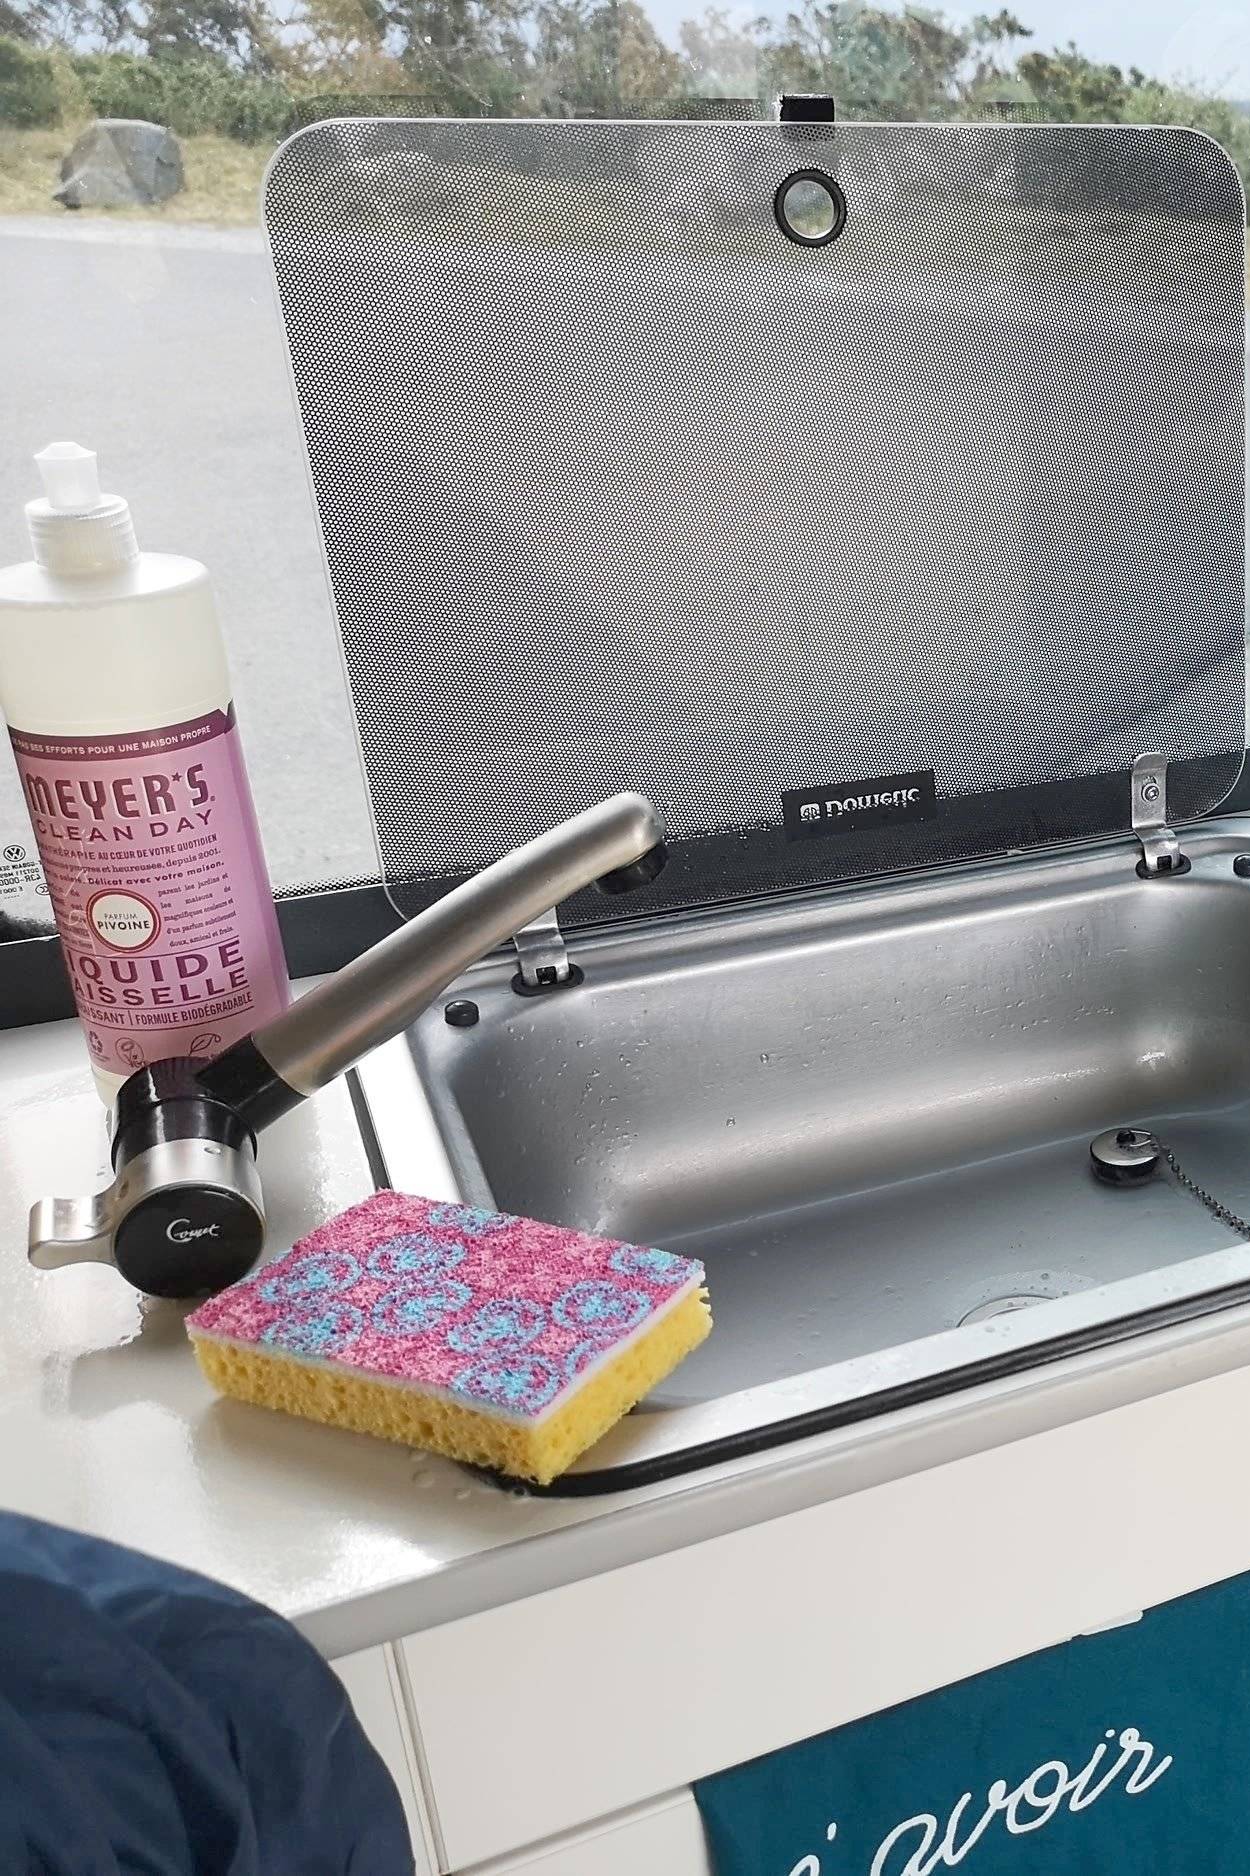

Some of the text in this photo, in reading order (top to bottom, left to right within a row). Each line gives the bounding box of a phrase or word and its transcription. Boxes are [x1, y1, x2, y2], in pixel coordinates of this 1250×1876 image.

[45, 745, 85, 755] EFFORTS
[88, 745, 115, 754] POUR
[119, 742, 140, 752] UNE
[142, 736, 178, 749] MAISON
[180, 725, 211, 741] PROPRE
[38, 809, 212, 842] CLEAN DAY
[98, 851, 108, 860] AU
[137, 849, 148, 858] DE
[148, 845, 176, 857] VOTRE
[177, 833, 217, 852] QUOTIDIEN
[166, 854, 197, 867] depuis
[198, 847, 221, 860] 2001.
[88, 878, 122, 886] Délicat
[126, 877, 151, 885] avec
[155, 871, 183, 882] votre
[187, 861, 224, 876] maison.
[97, 920, 150, 931] PIVOINE
[67, 940, 244, 985] IQUIDE
[74, 967, 248, 1006] AISSELLE
[136, 1011, 180, 1025] FORMULE
[181, 991, 253, 1021] BIODÉGRADABLE
[788, 1727, 1173, 1876] 'avoir
